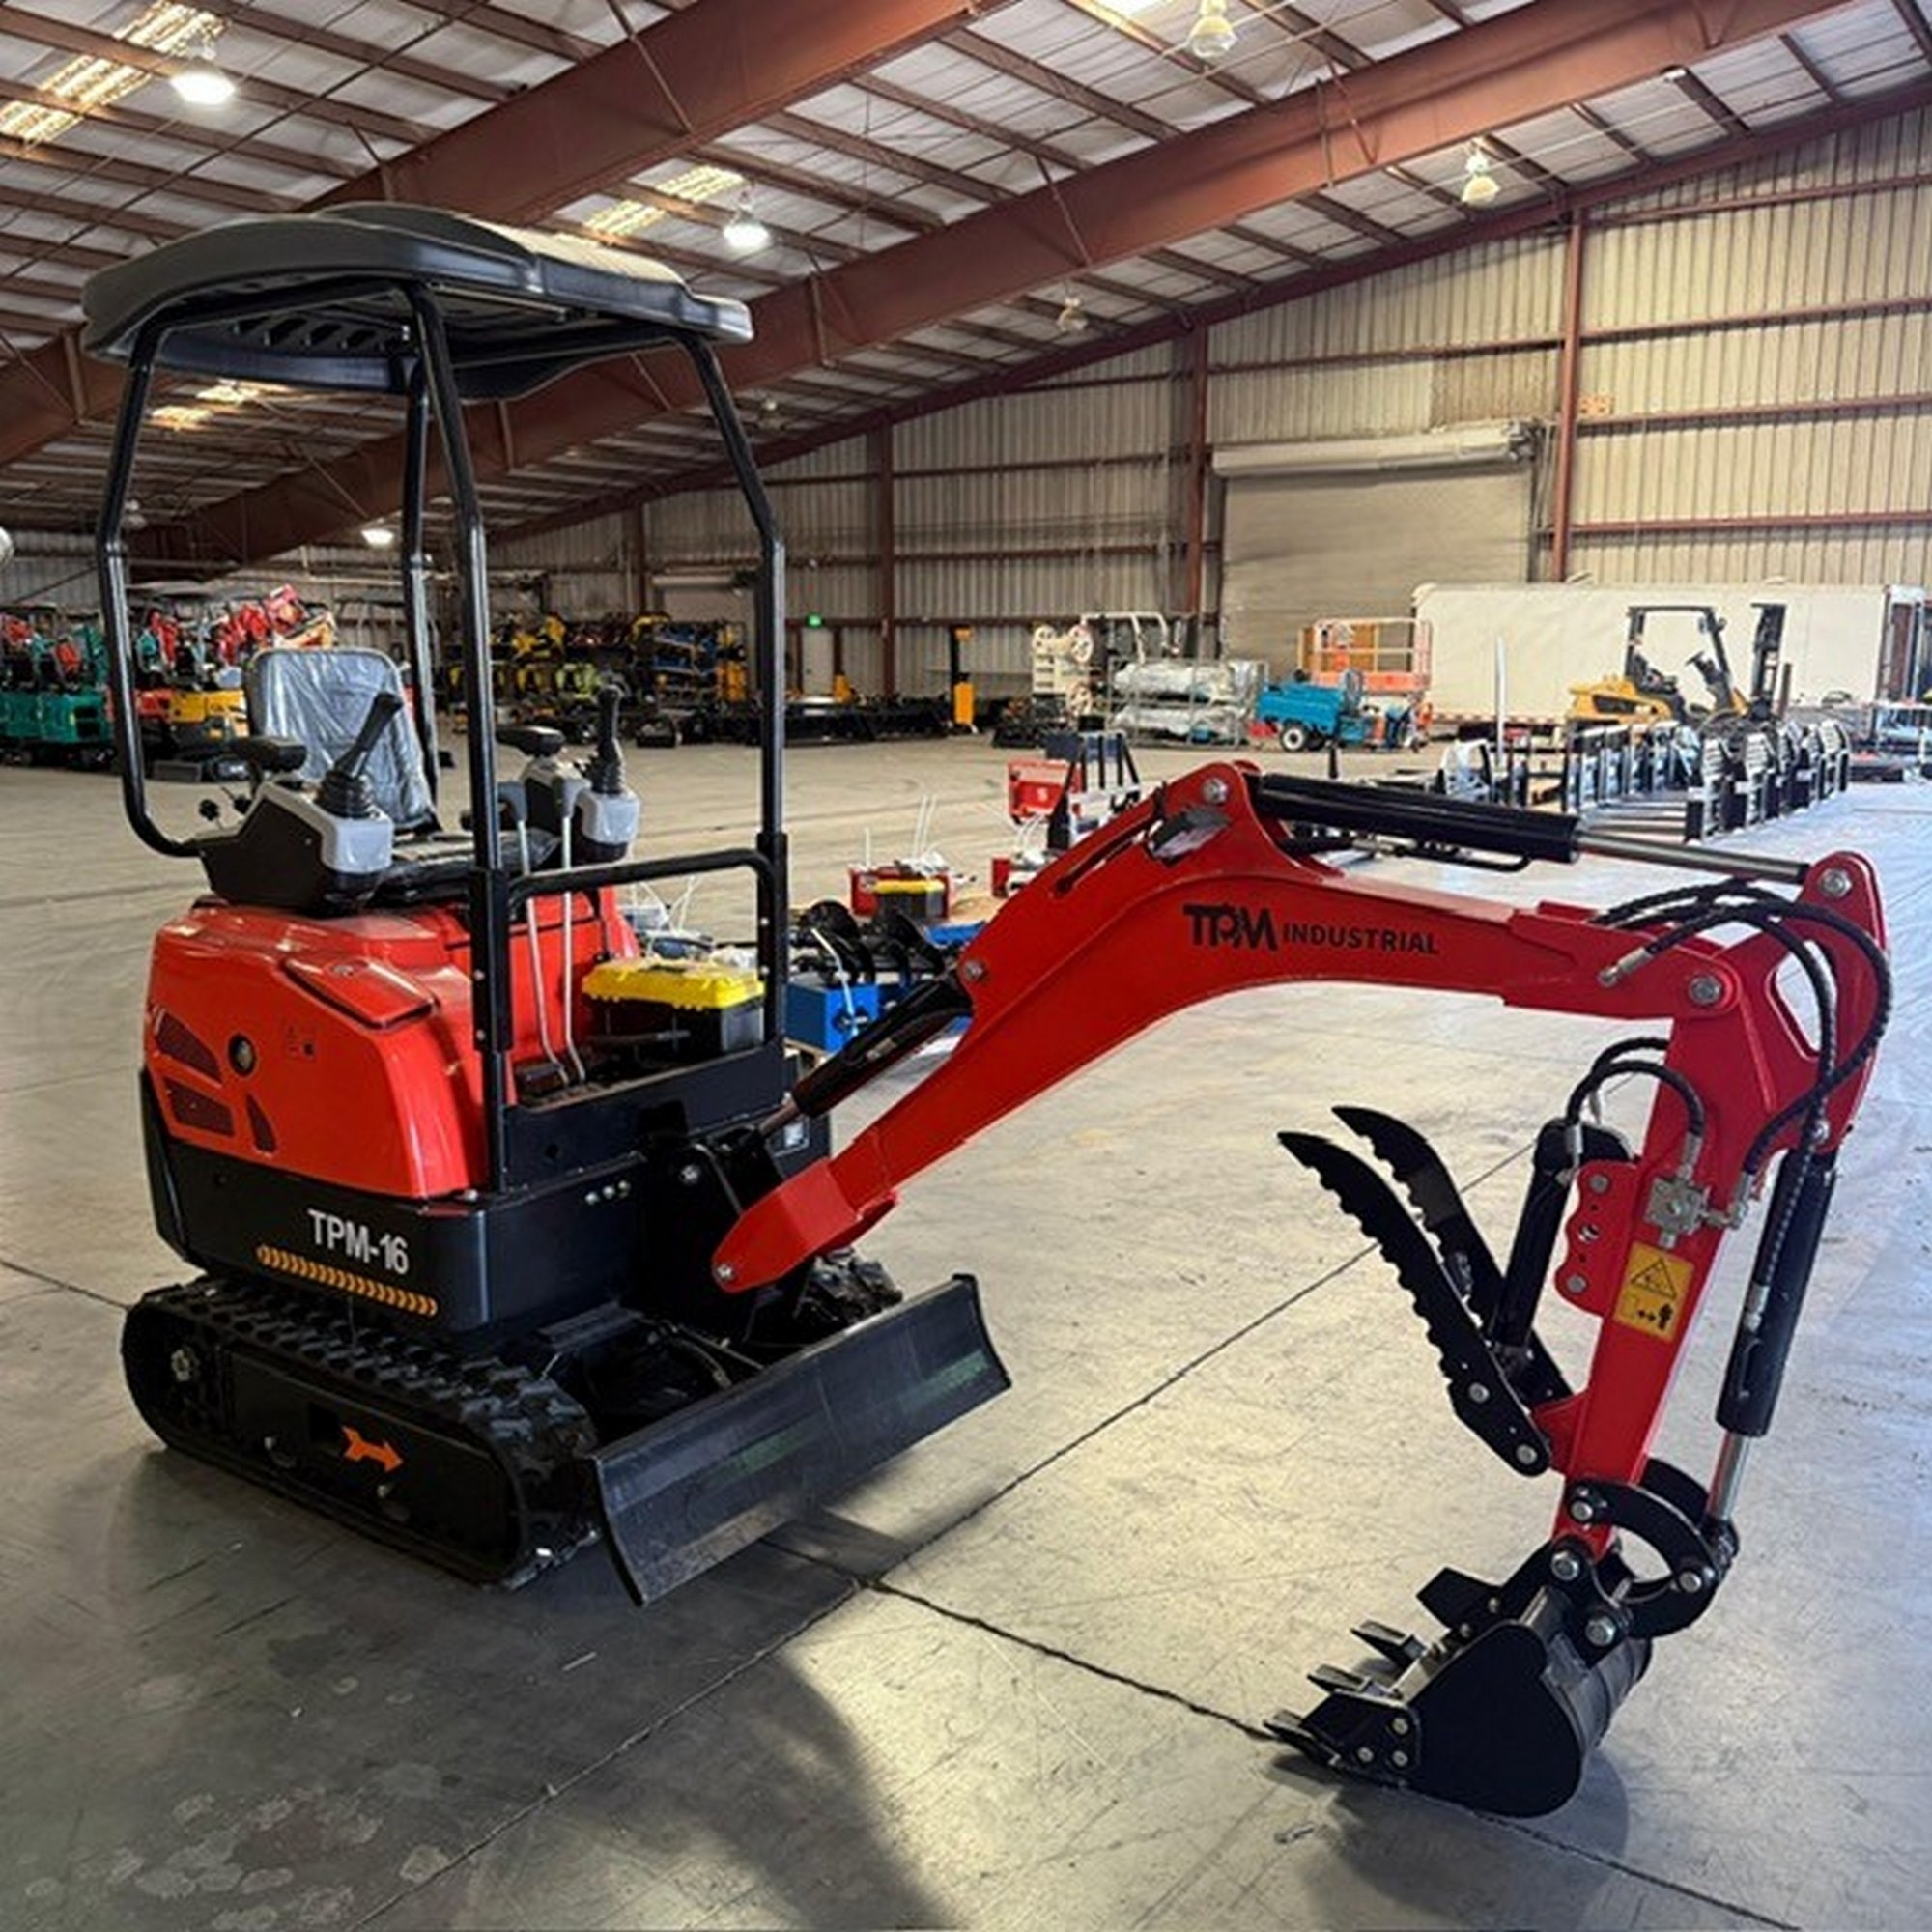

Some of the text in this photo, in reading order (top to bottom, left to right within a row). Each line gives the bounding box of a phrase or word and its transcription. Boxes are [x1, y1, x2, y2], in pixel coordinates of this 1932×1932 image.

[1182, 902, 1439, 954] TPM INDUSTRIAL
[307, 1208, 409, 1275] TPM-16
